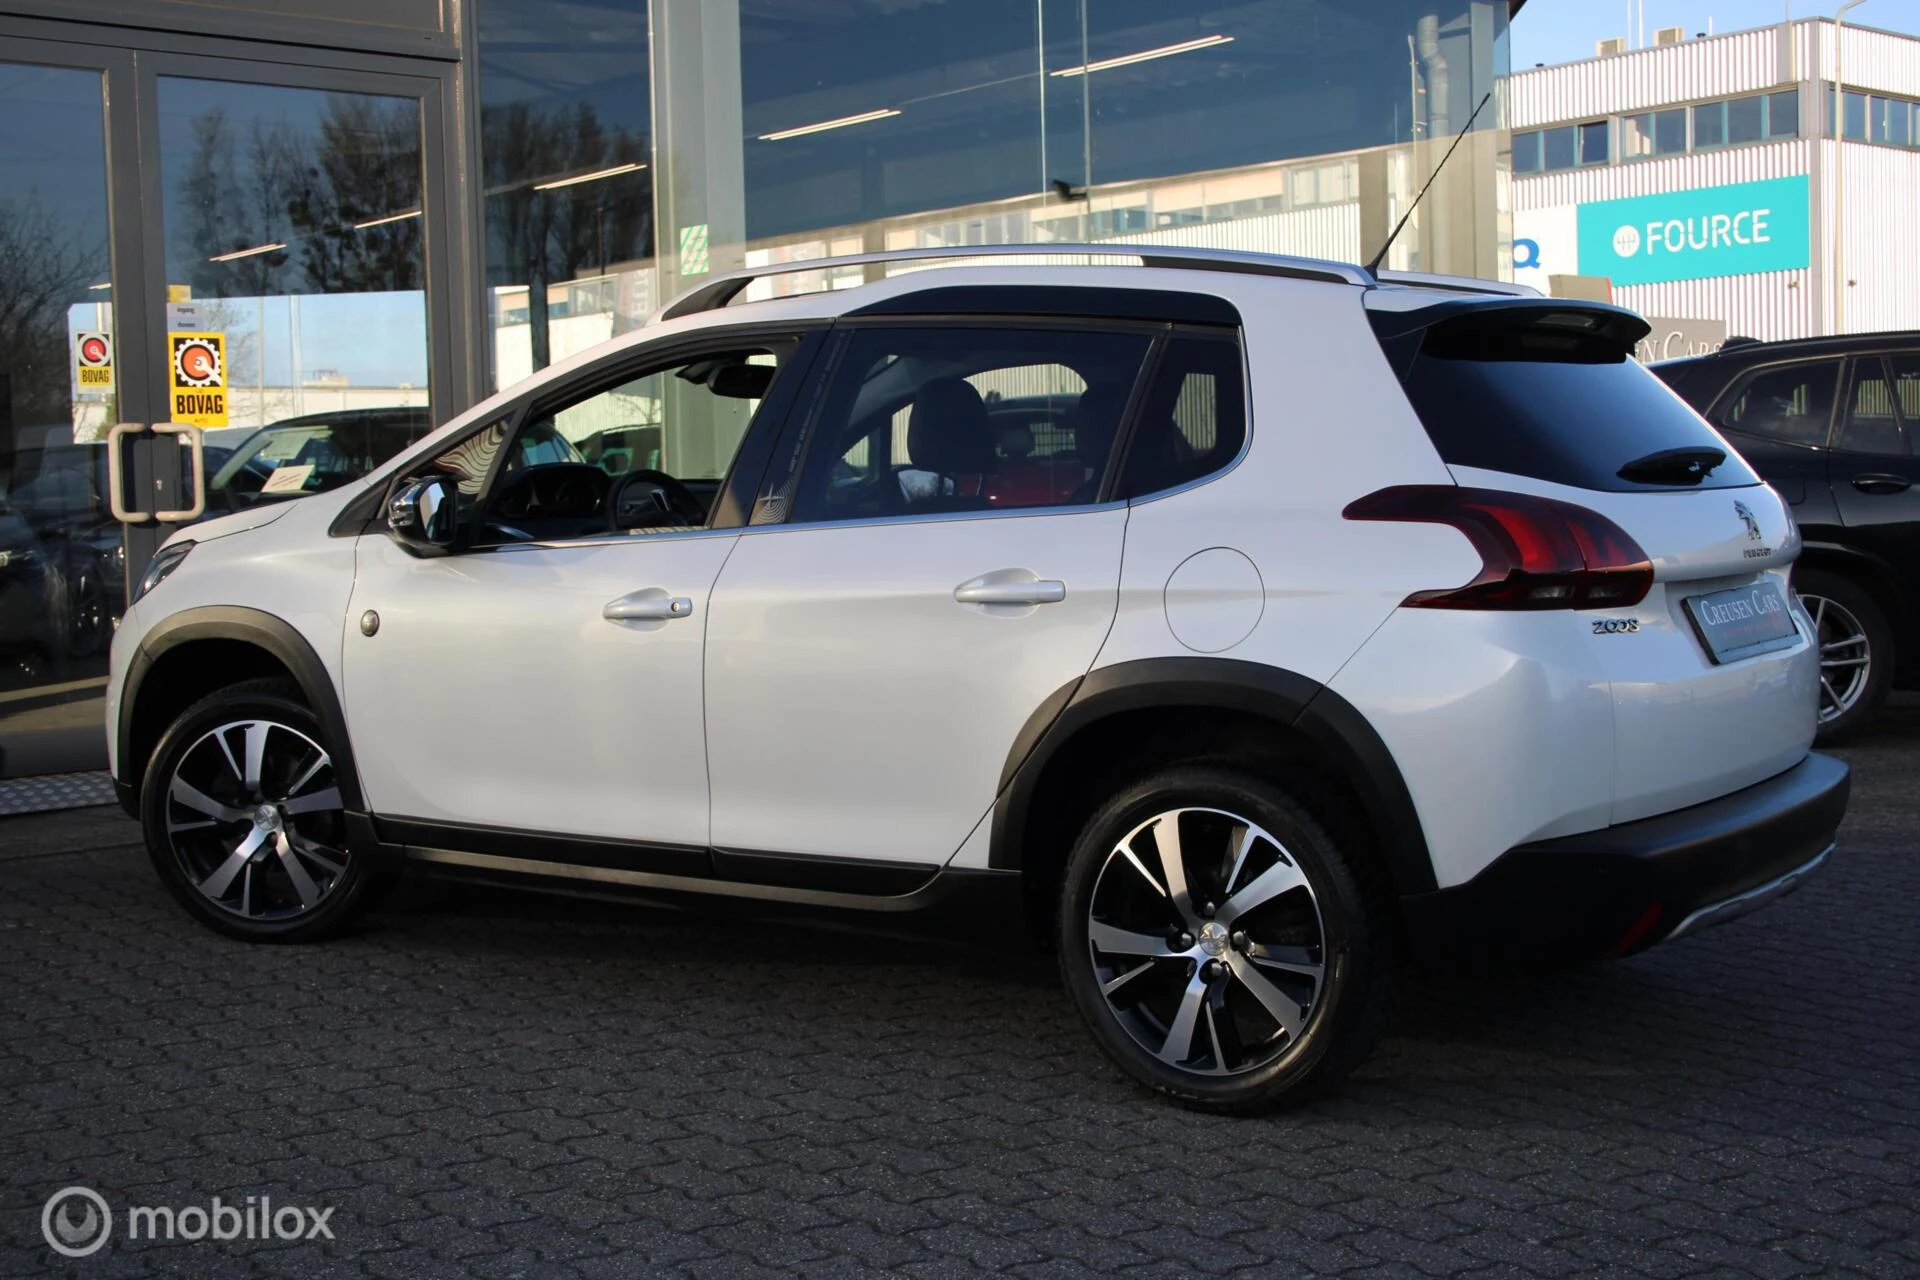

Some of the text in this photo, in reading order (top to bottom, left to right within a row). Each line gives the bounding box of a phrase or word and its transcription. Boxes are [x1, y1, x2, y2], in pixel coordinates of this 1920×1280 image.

[1646, 208, 1770, 255] FOURCE
[82, 369, 110, 383] BOVAG
[176, 394, 223, 414] BOVAG
[1700, 590, 1781, 625] CREUSEN CARS
[1592, 618, 1640, 634] 2008
